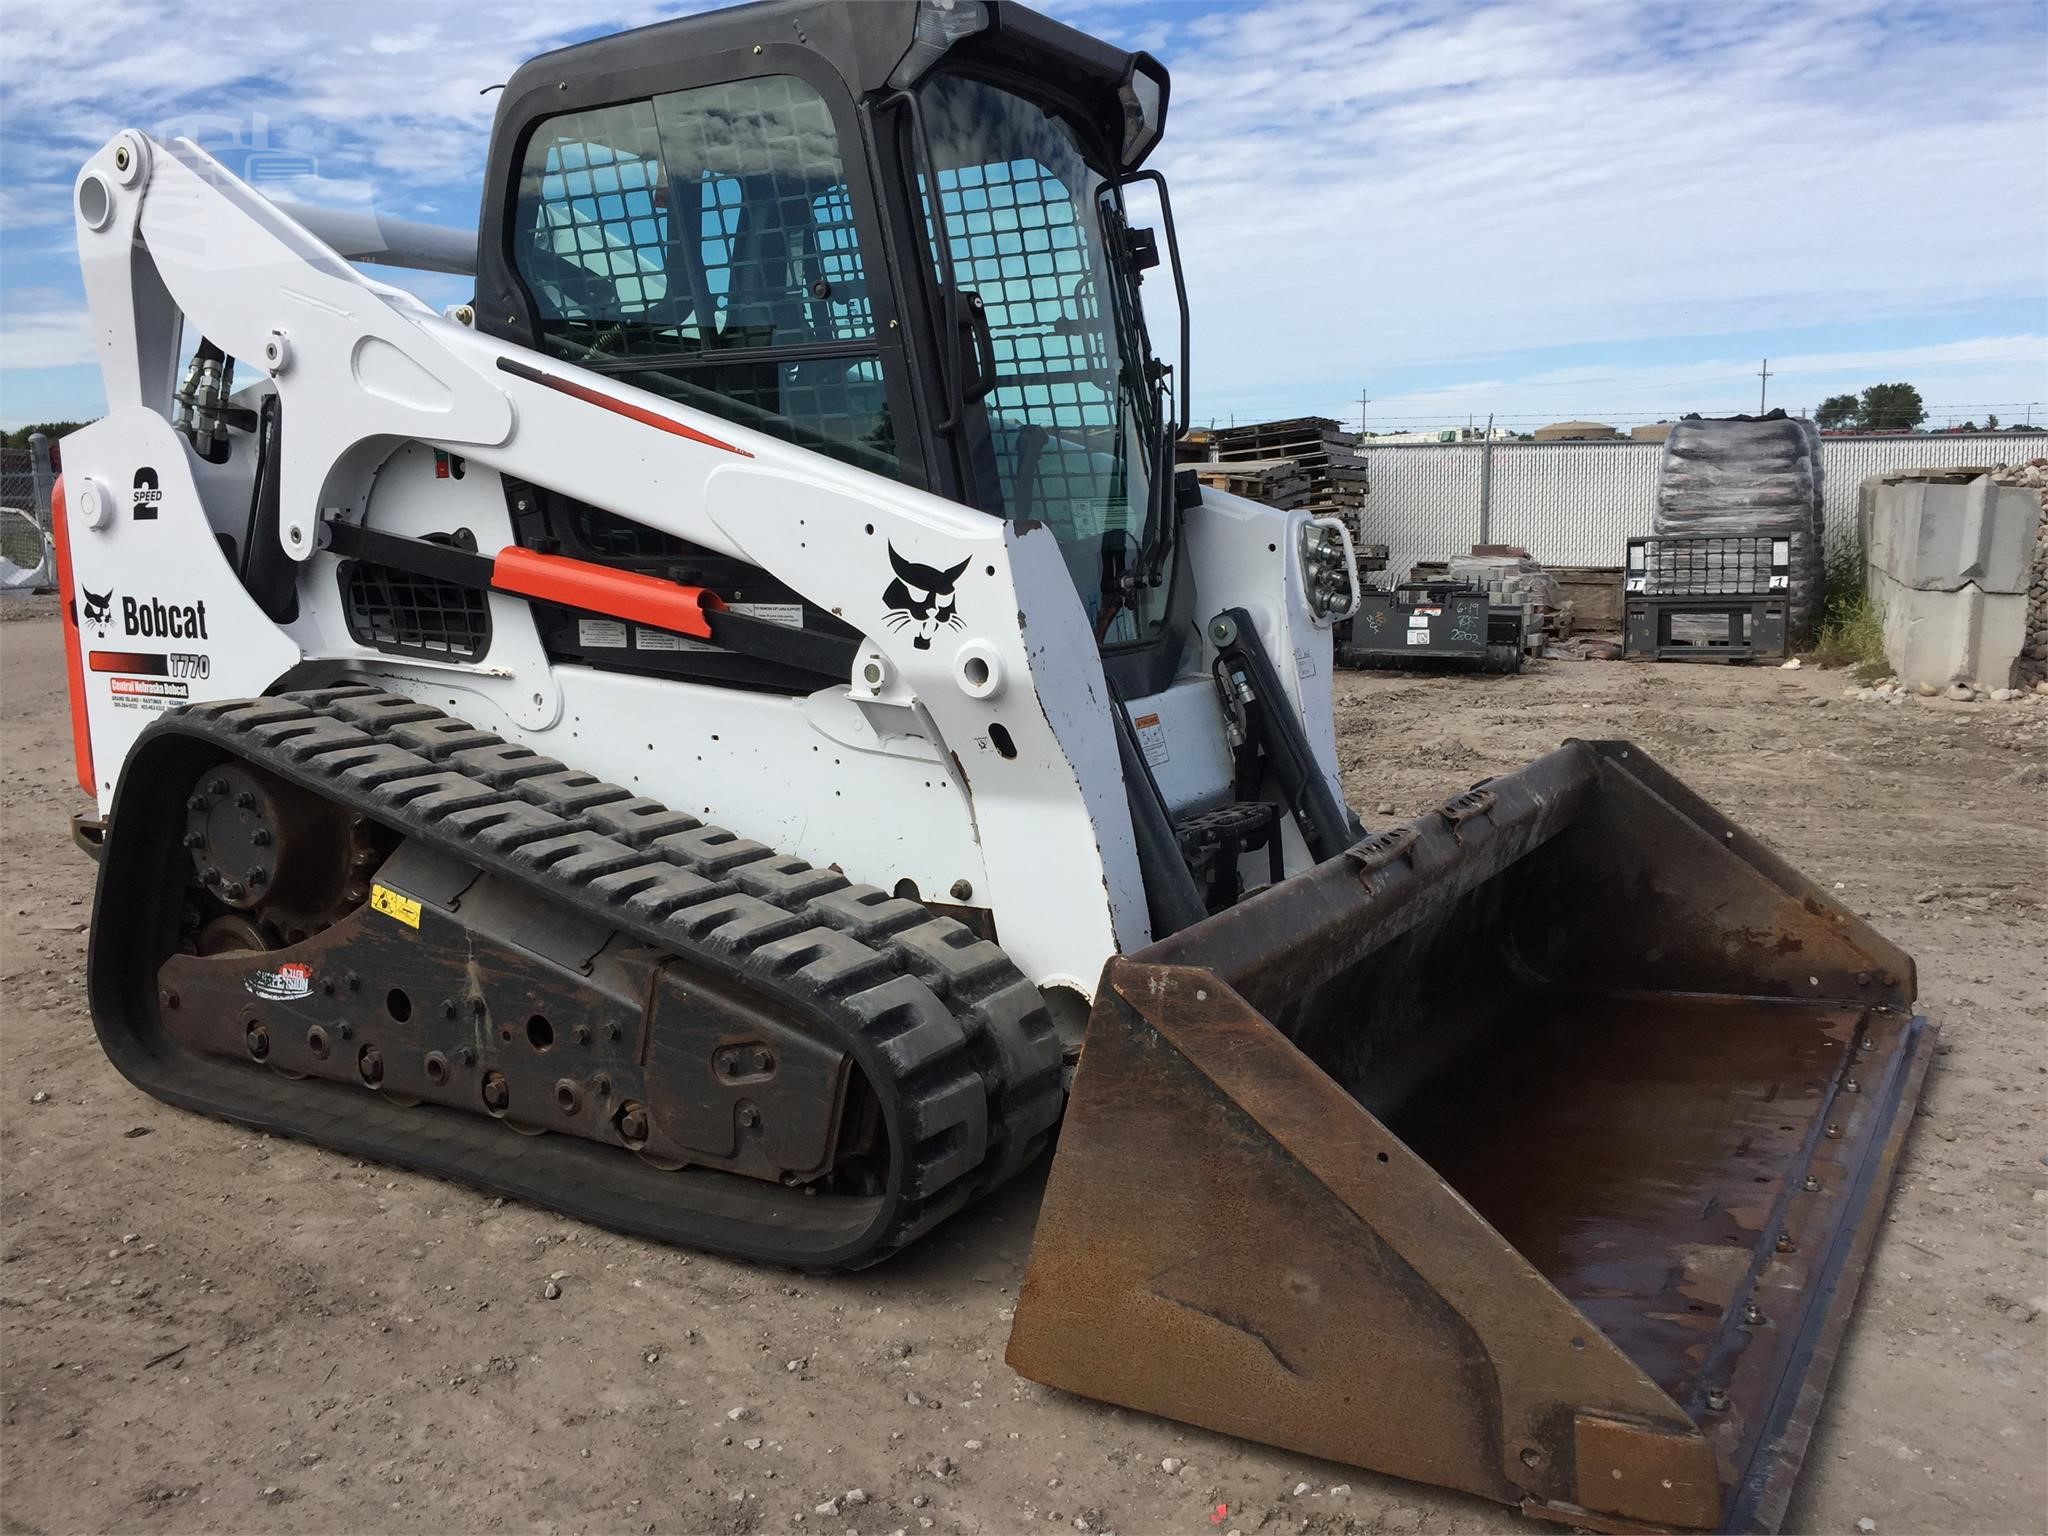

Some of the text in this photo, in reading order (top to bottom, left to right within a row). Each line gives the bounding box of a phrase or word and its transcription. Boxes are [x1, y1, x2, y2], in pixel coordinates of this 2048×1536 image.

[133, 466, 159, 520] 2
[133, 491, 162, 502] SPEED
[122, 596, 208, 640] Bobcat
[170, 653, 210, 679] T770
